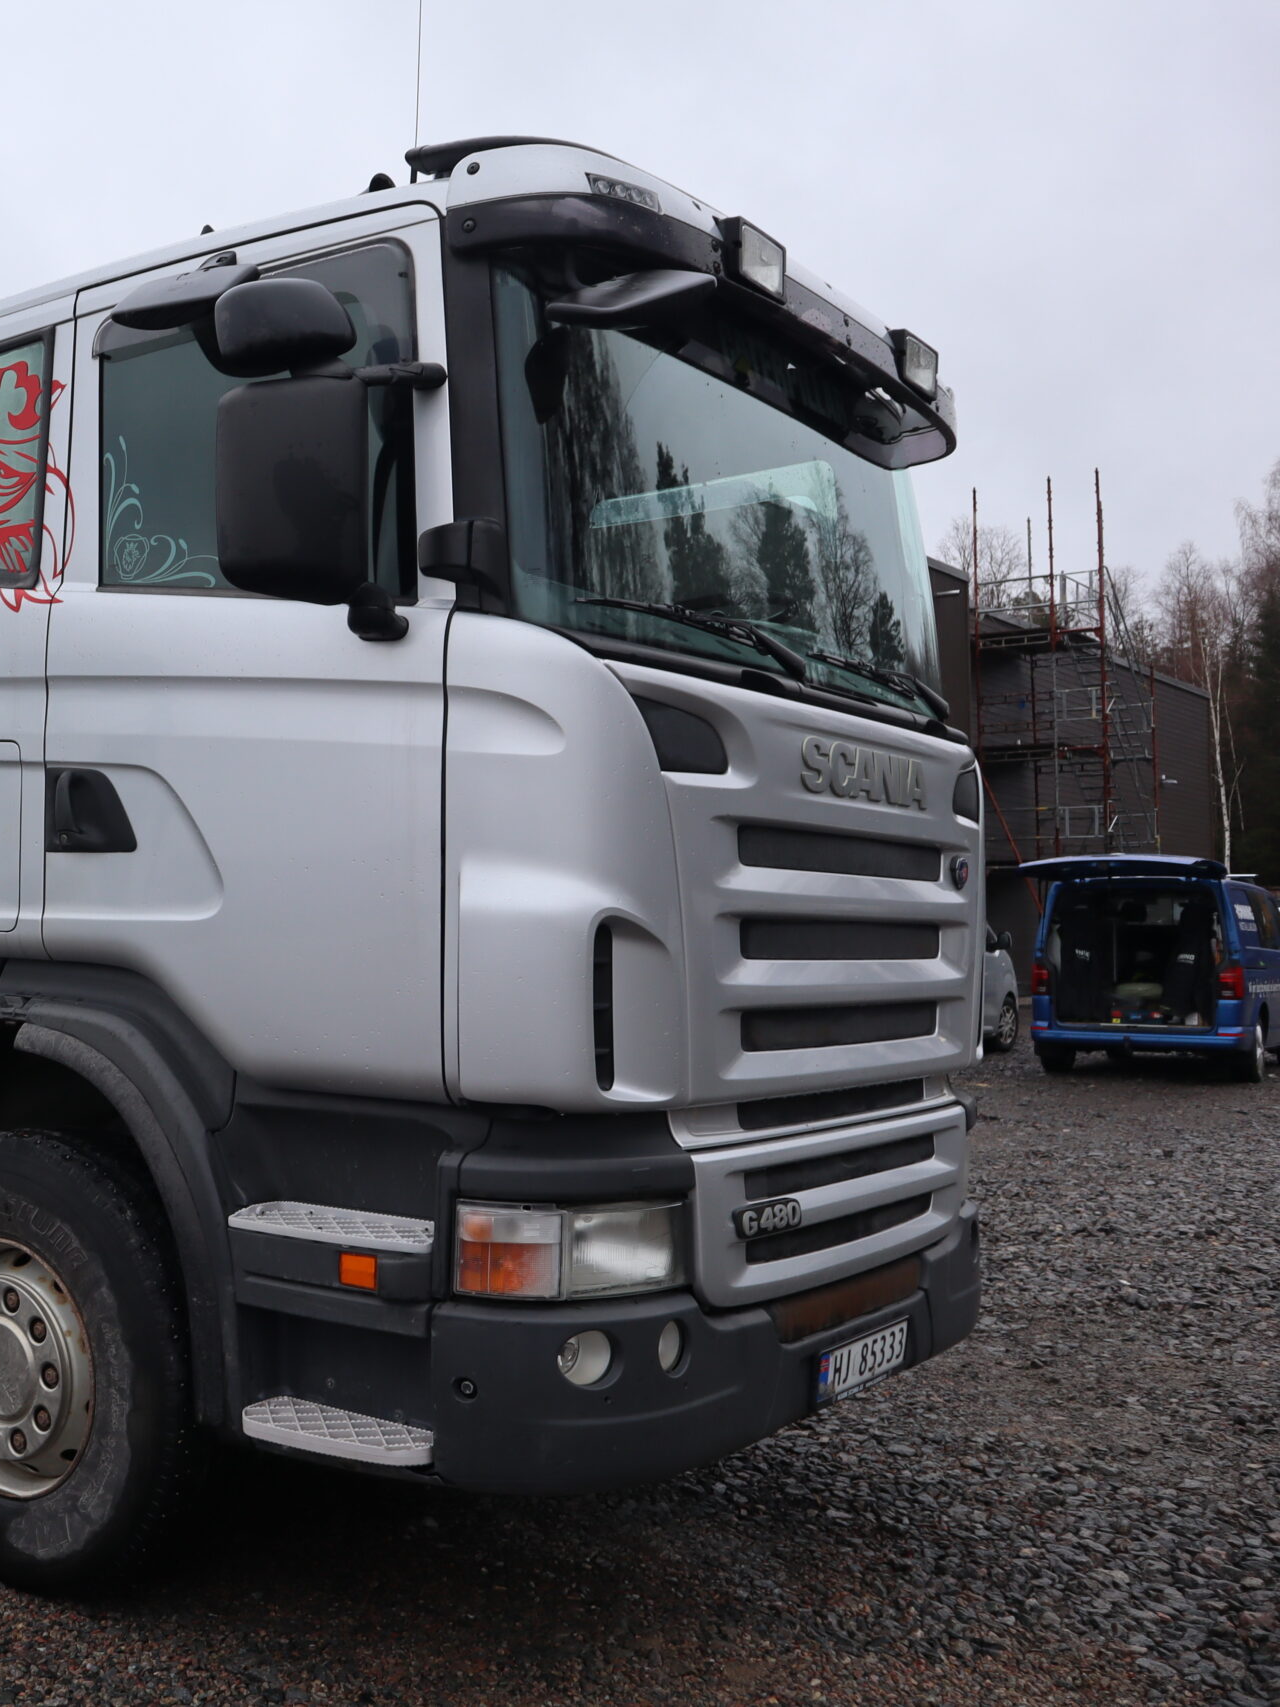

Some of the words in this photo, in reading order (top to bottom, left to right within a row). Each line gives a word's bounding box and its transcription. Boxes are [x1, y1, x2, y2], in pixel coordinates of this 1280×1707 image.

[801, 735, 927, 811] SCANIA
[742, 1201, 801, 1236] G480
[833, 1349, 851, 1386] HJ
[859, 1327, 904, 1377] 85333
